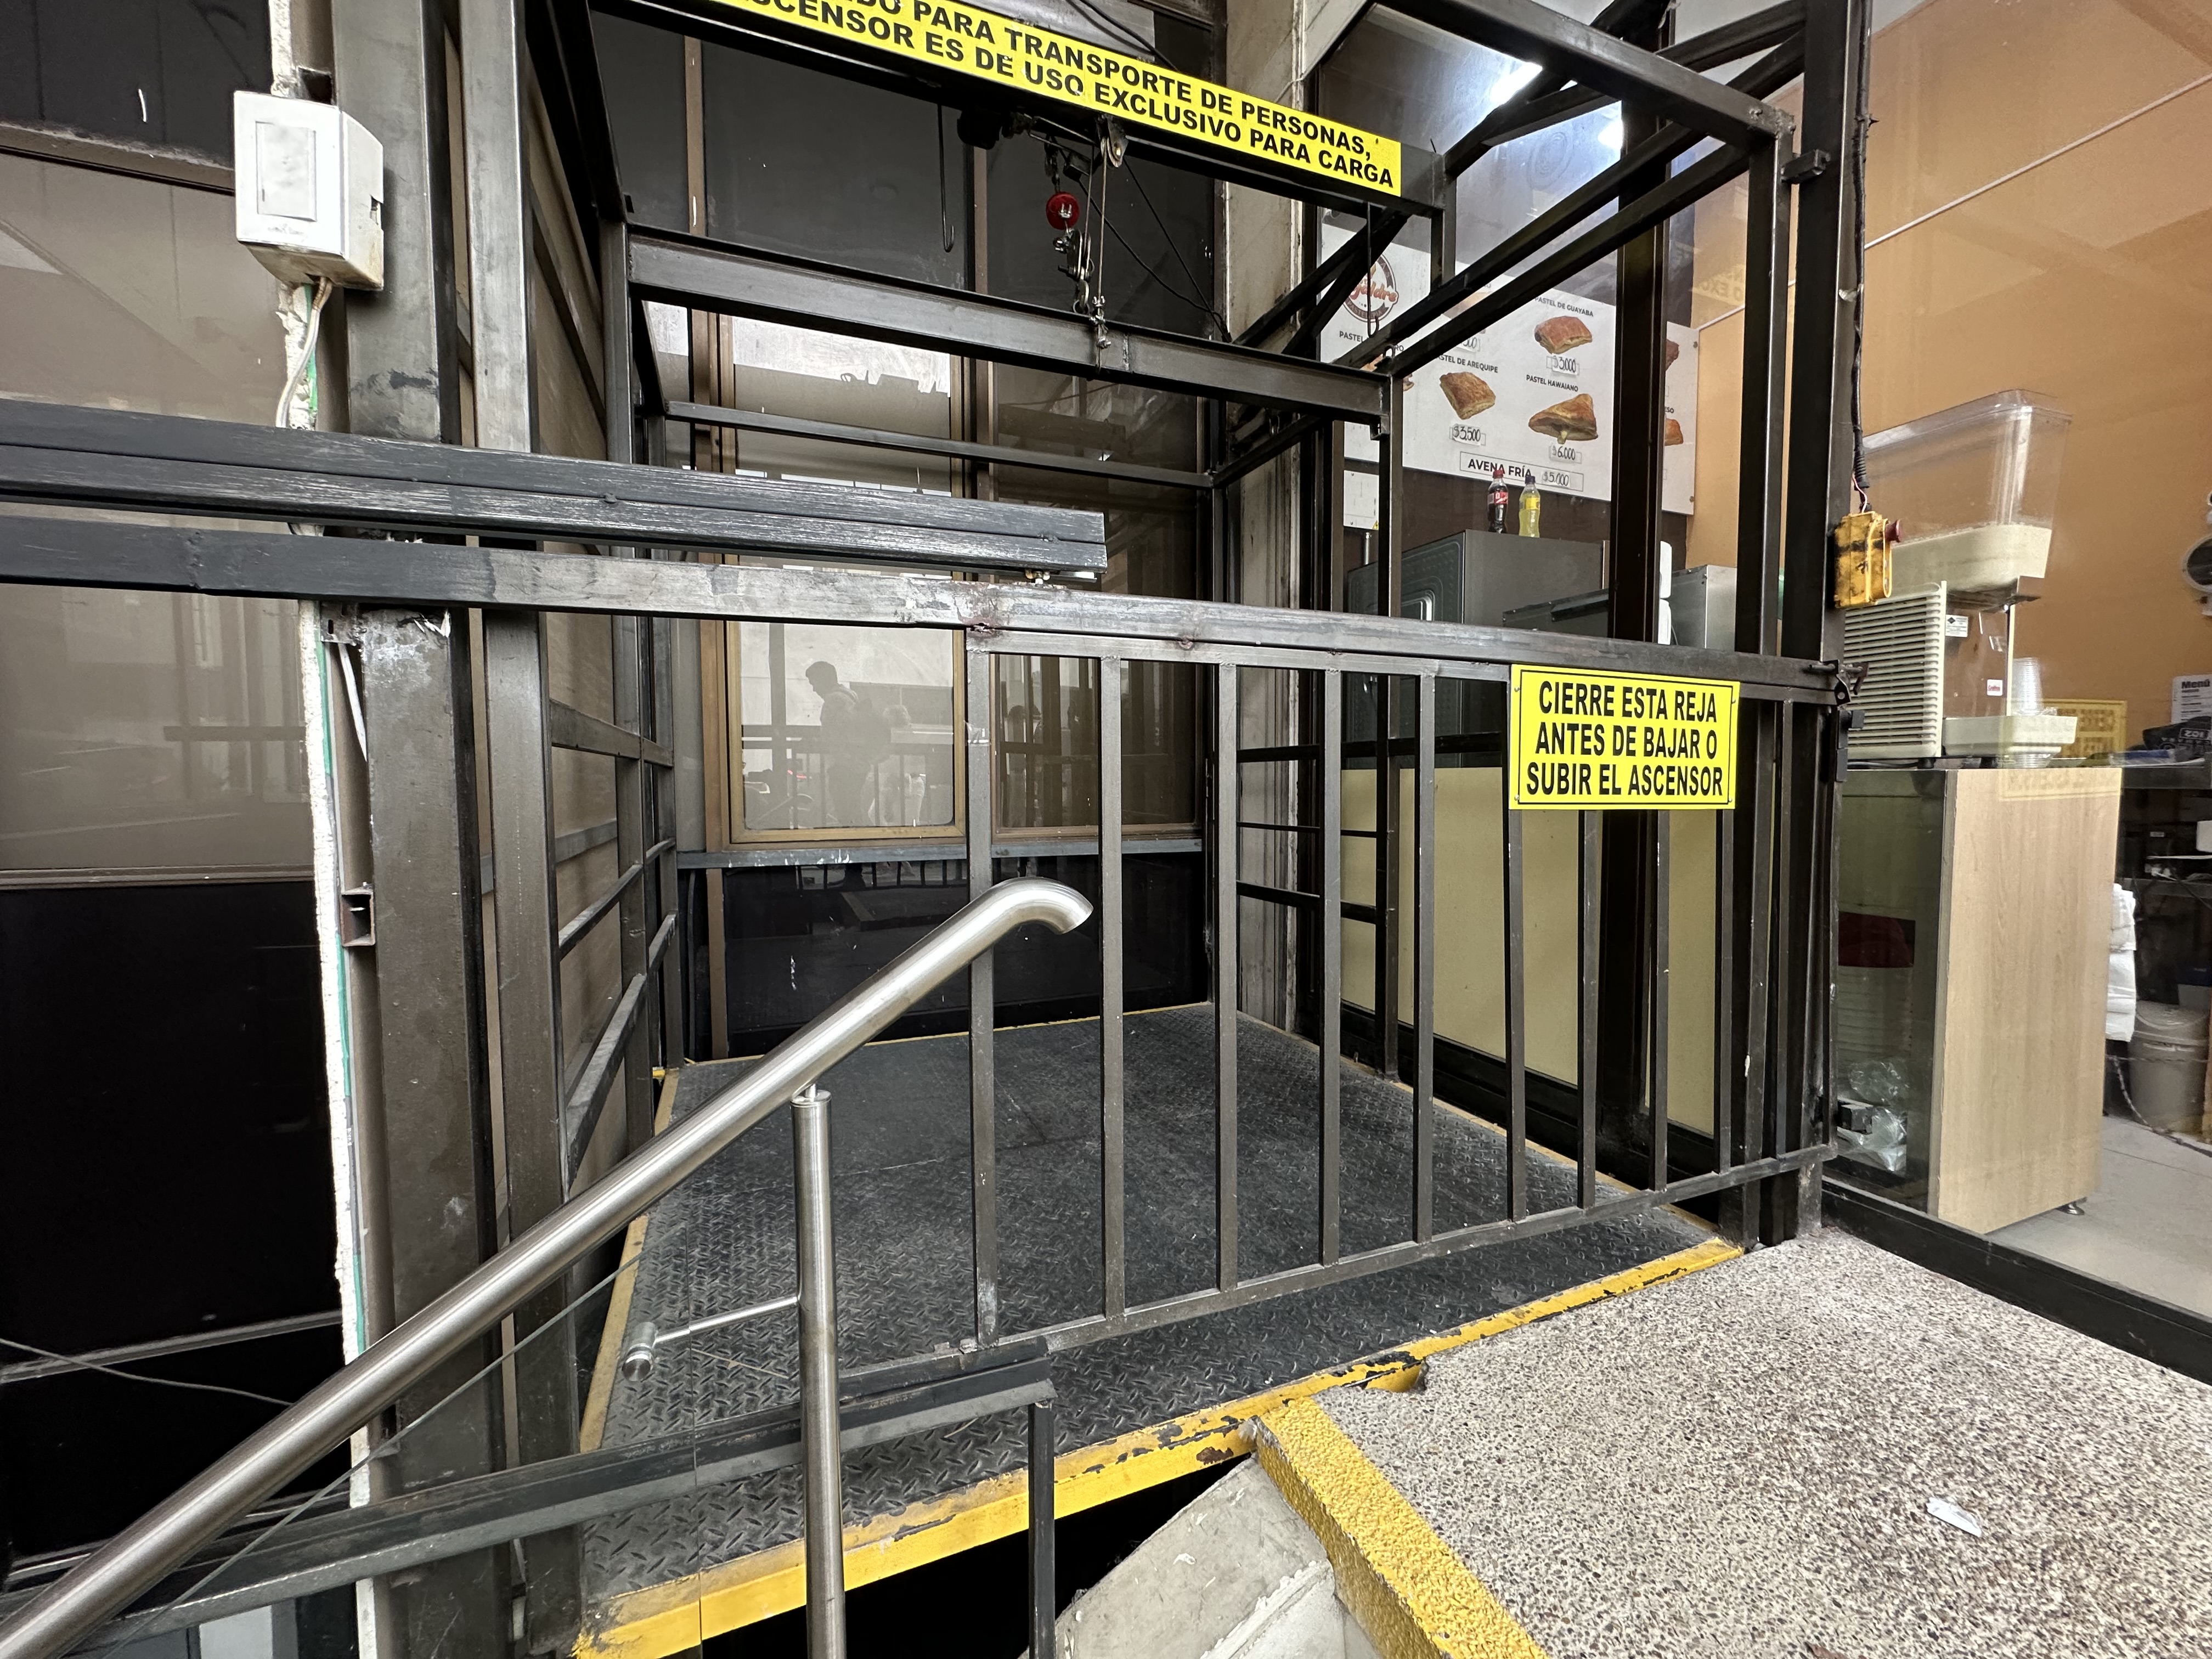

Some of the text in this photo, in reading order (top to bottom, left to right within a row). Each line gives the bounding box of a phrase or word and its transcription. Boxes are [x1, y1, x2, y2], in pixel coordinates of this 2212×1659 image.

[913, 0, 1370, 161] PARA TRANSPORTE DE PERSONAS,
[926, 31, 964, 62] ES
[975, 46, 1014, 78] DE
[1025, 60, 1084, 97] USO
[1095, 81, 1241, 142] EXCLUSIVO
[1250, 128, 1311, 164] PARA
[1318, 150, 1394, 188] CARGA
[1535, 297, 1556, 307] PASTEL
[1567, 304, 1594, 317] GUAYABA
[1339, 330, 1365, 342] PASTEL
[1457, 357, 1466, 366] DE
[1467, 360, 1498, 374] AREQUIPE
[1526, 375, 1578, 392] PASTEL HAWAIANO
[1468, 459, 1532, 478] AVENA FRÍA
[2181, 679, 2210, 689] Menú
[1539, 680, 1717, 723] CIERRE ESTA REJA
[1535, 722, 1717, 760] ANTES DE BAJAR O
[1526, 761, 1723, 796] SUBIR EL ASCENSOR
